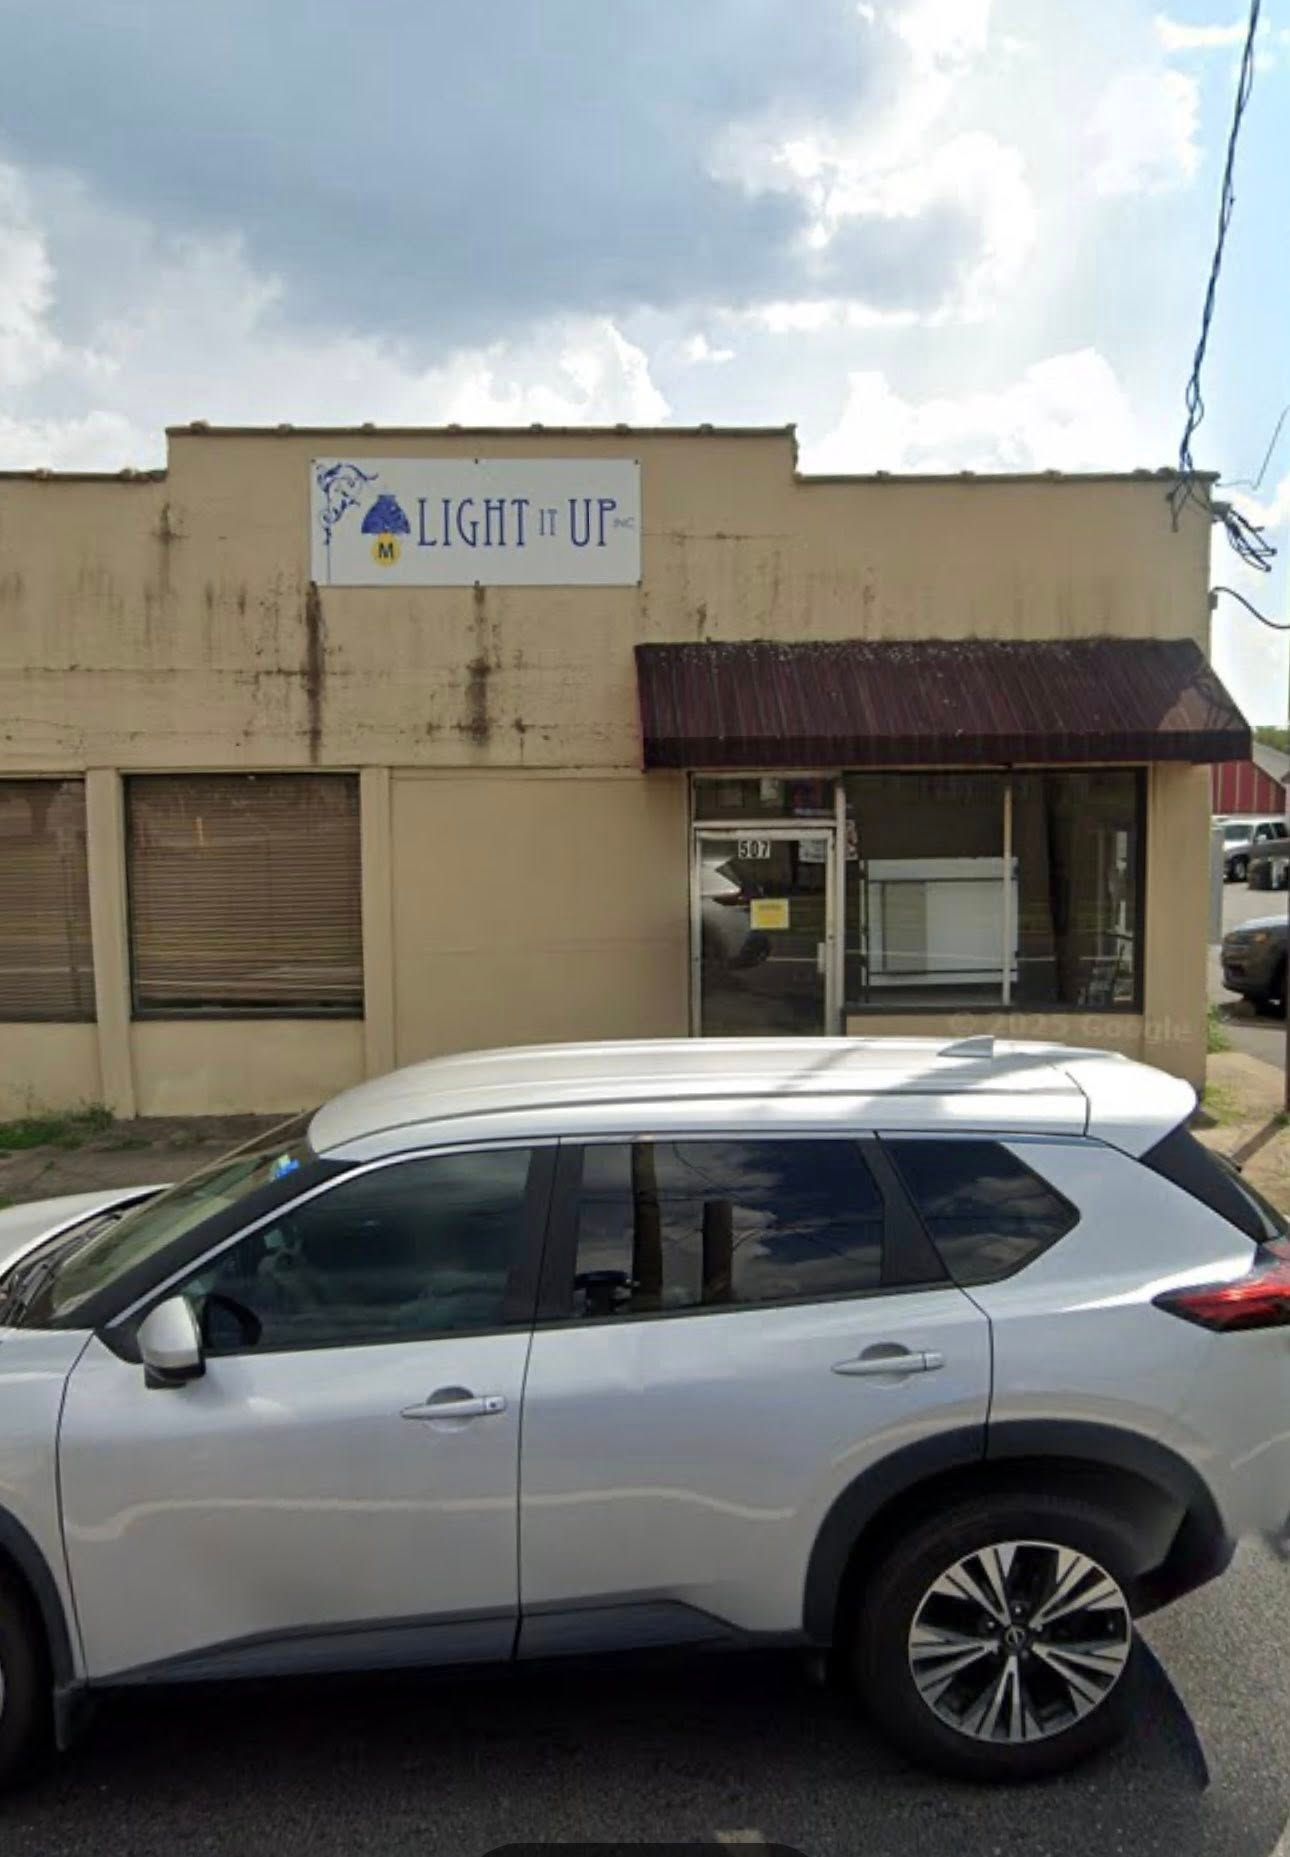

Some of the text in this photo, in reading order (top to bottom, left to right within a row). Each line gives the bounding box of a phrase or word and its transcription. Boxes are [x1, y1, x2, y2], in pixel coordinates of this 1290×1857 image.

[417, 498, 529, 548] LIGHT
[538, 508, 558, 537] IT
[568, 498, 617, 547] UP
[378, 543, 394, 558] M
[740, 840, 768, 858] 507
